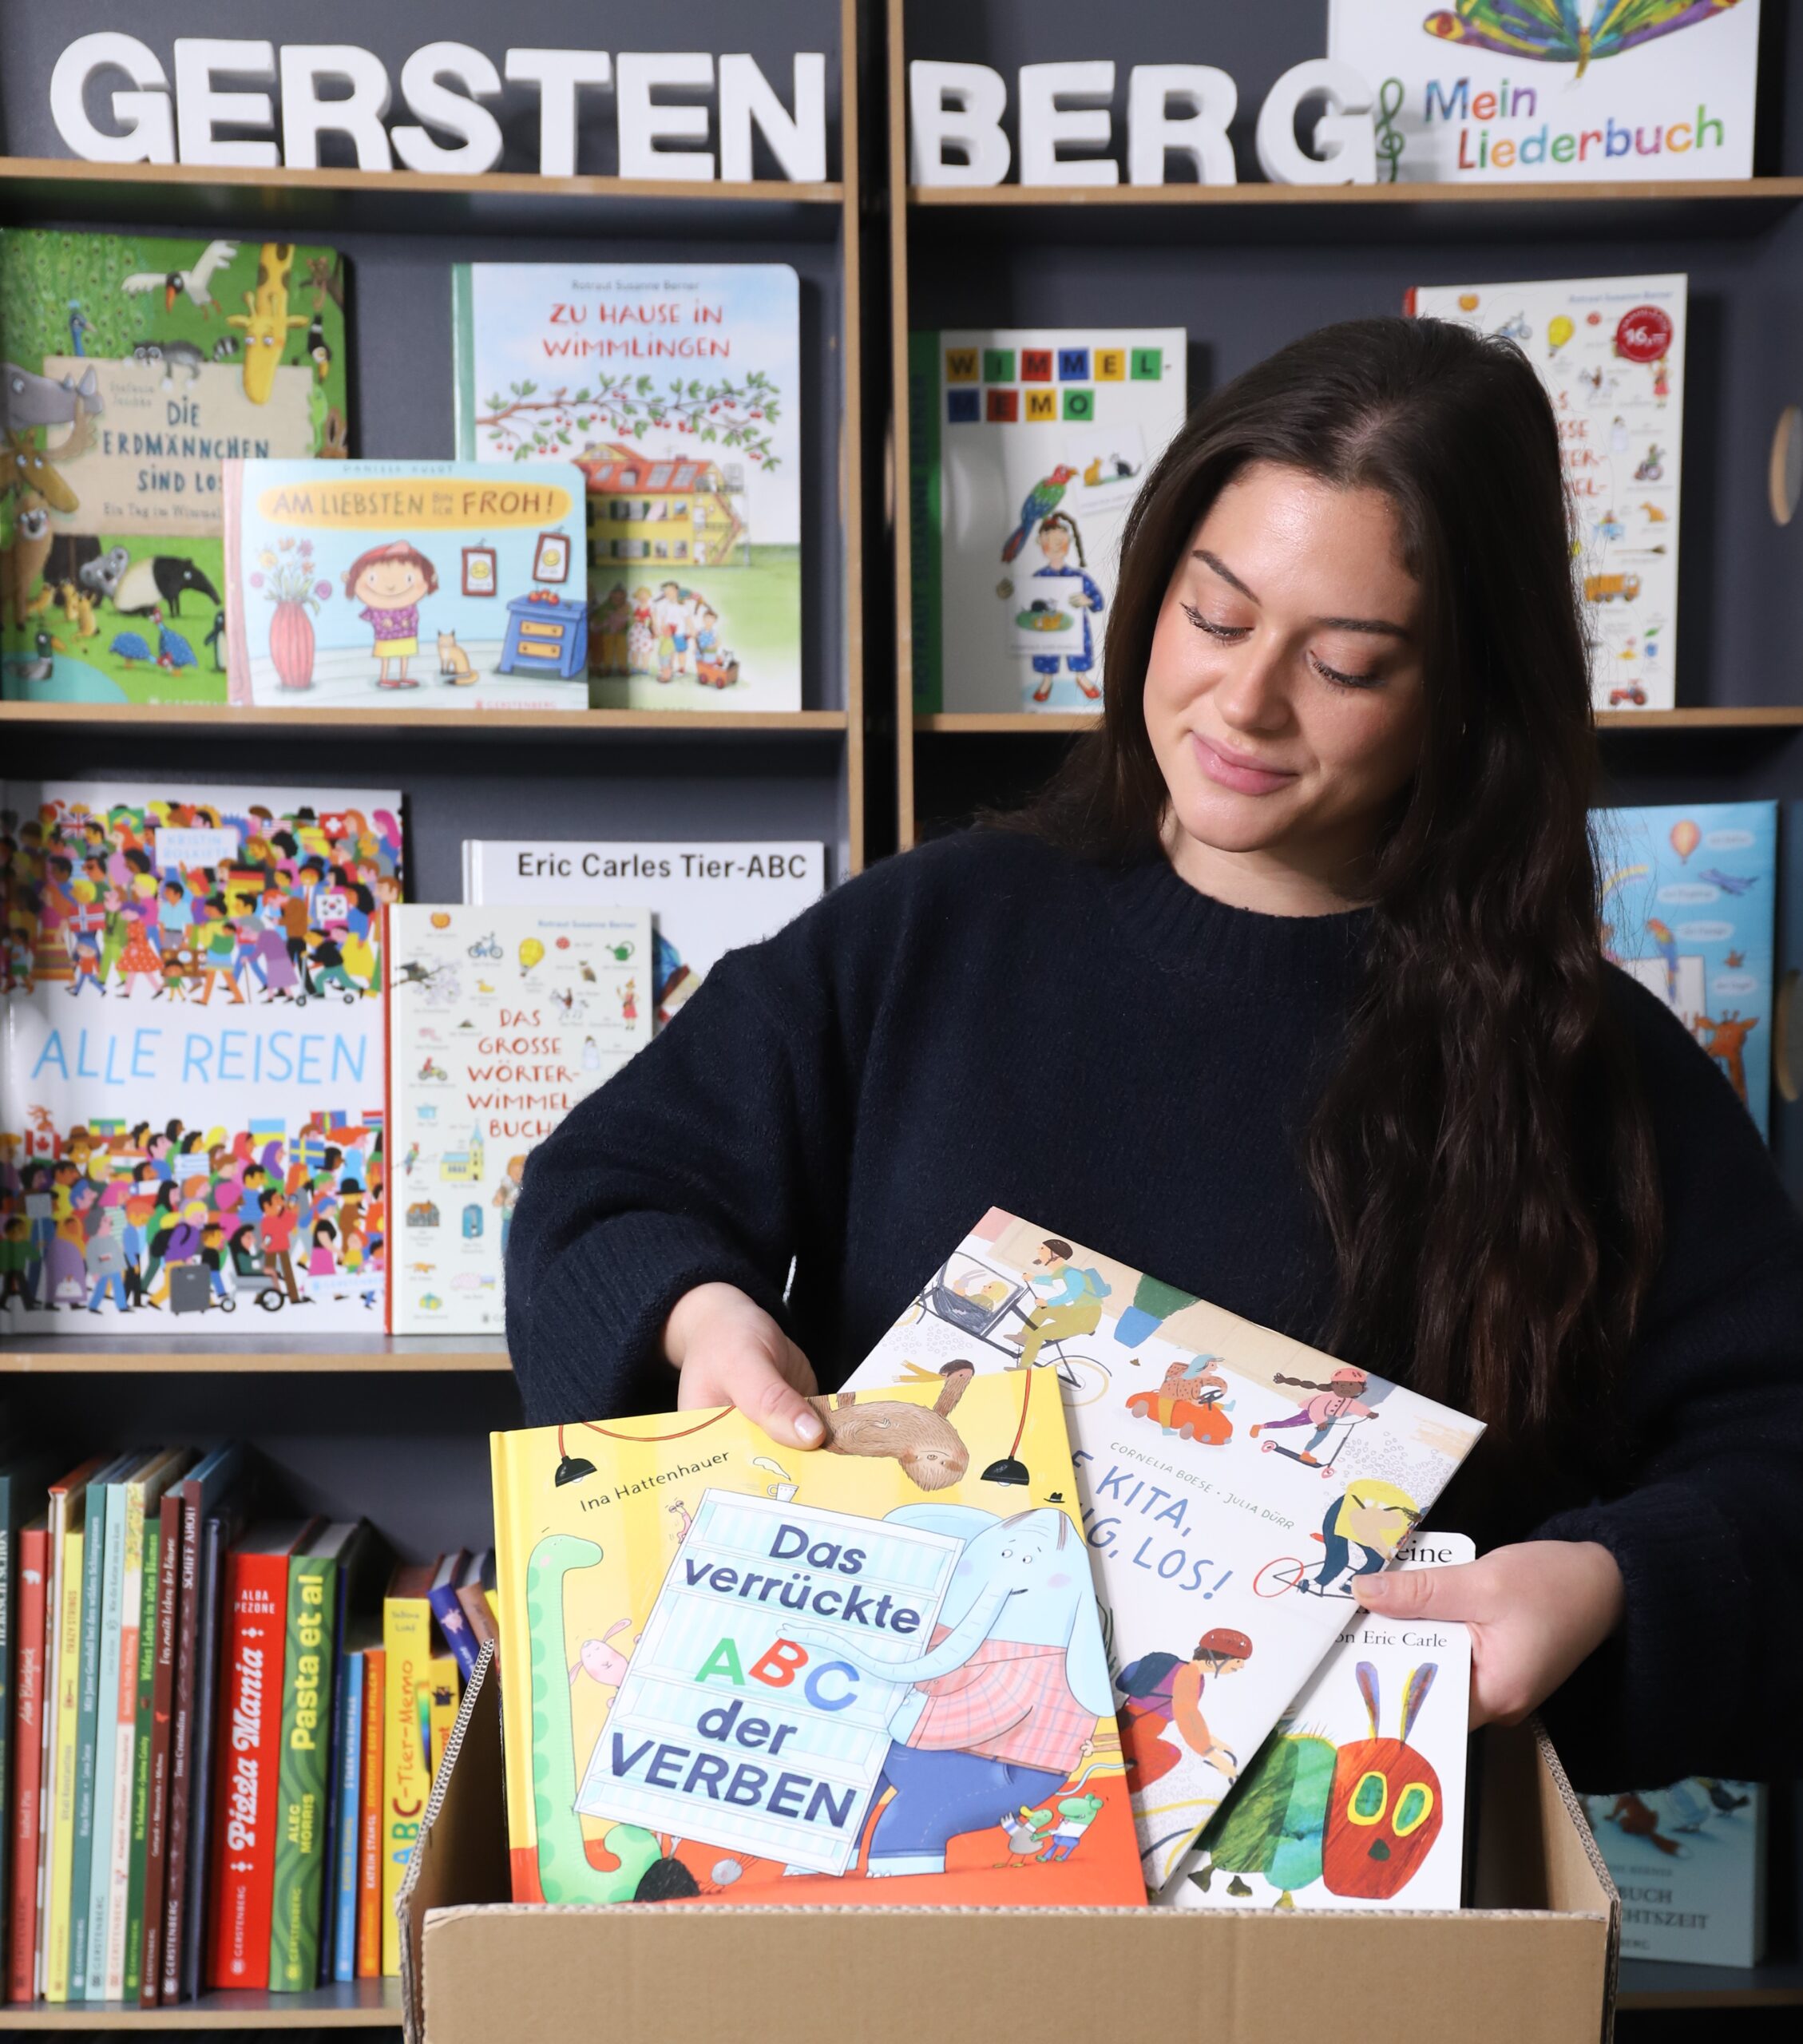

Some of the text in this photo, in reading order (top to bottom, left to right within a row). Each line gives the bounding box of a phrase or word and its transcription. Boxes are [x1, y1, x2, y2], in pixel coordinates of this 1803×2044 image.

[50, 31, 1377, 187] GERSTEN BERG
[1425, 77, 1538, 122] Mein
[1458, 104, 1725, 170] Liederbuch
[549, 303, 587, 325] ZU
[600, 302, 681, 325] HAUSE
[950, 393, 1089, 417] MEMO
[103, 430, 269, 459] ERDMÄNNCHEN
[272, 490, 314, 515] AM
[321, 490, 425, 516] LIEBSTEN
[462, 489, 556, 516] FROH!
[517, 852, 808, 880] Eric Carles Tier-ABC
[499, 1008, 541, 1028] DAS
[30, 1027, 368, 1085] ALLE REISEN
[467, 1060, 581, 1083] WÖRTER-
[477, 1036, 562, 1056] GROSSE
[579, 1451, 730, 1513] Ina Hattenhauer
[1095, 1464, 1192, 1538] KITA,
[1109, 1440, 1175, 1474] CORNELIA
[1175, 1468, 1215, 1495] BOESE
[1222, 1491, 1259, 1515] JULIA
[1261, 1507, 1296, 1531] DÜRR
[182, 1546, 196, 1590] SCHIFF
[768, 1523, 867, 1575] Das
[1131, 1535, 1234, 1601] LOS!
[241, 1589, 269, 1602] ALBA
[684, 1558, 921, 1635] verrückte
[141, 1616, 154, 1647] Leben
[1363, 1630, 1397, 1646] Eric
[1401, 1632, 1448, 1648] Carle
[140, 1648, 153, 1682] Wildes
[290, 1575, 324, 1751] Pasta et al
[693, 1637, 861, 1713] ABC
[227, 1646, 264, 1852] Pizza Mania
[695, 1698, 798, 1756] der
[611, 1732, 858, 1829] VERBEN
[300, 1792, 315, 1853] MORRIS
